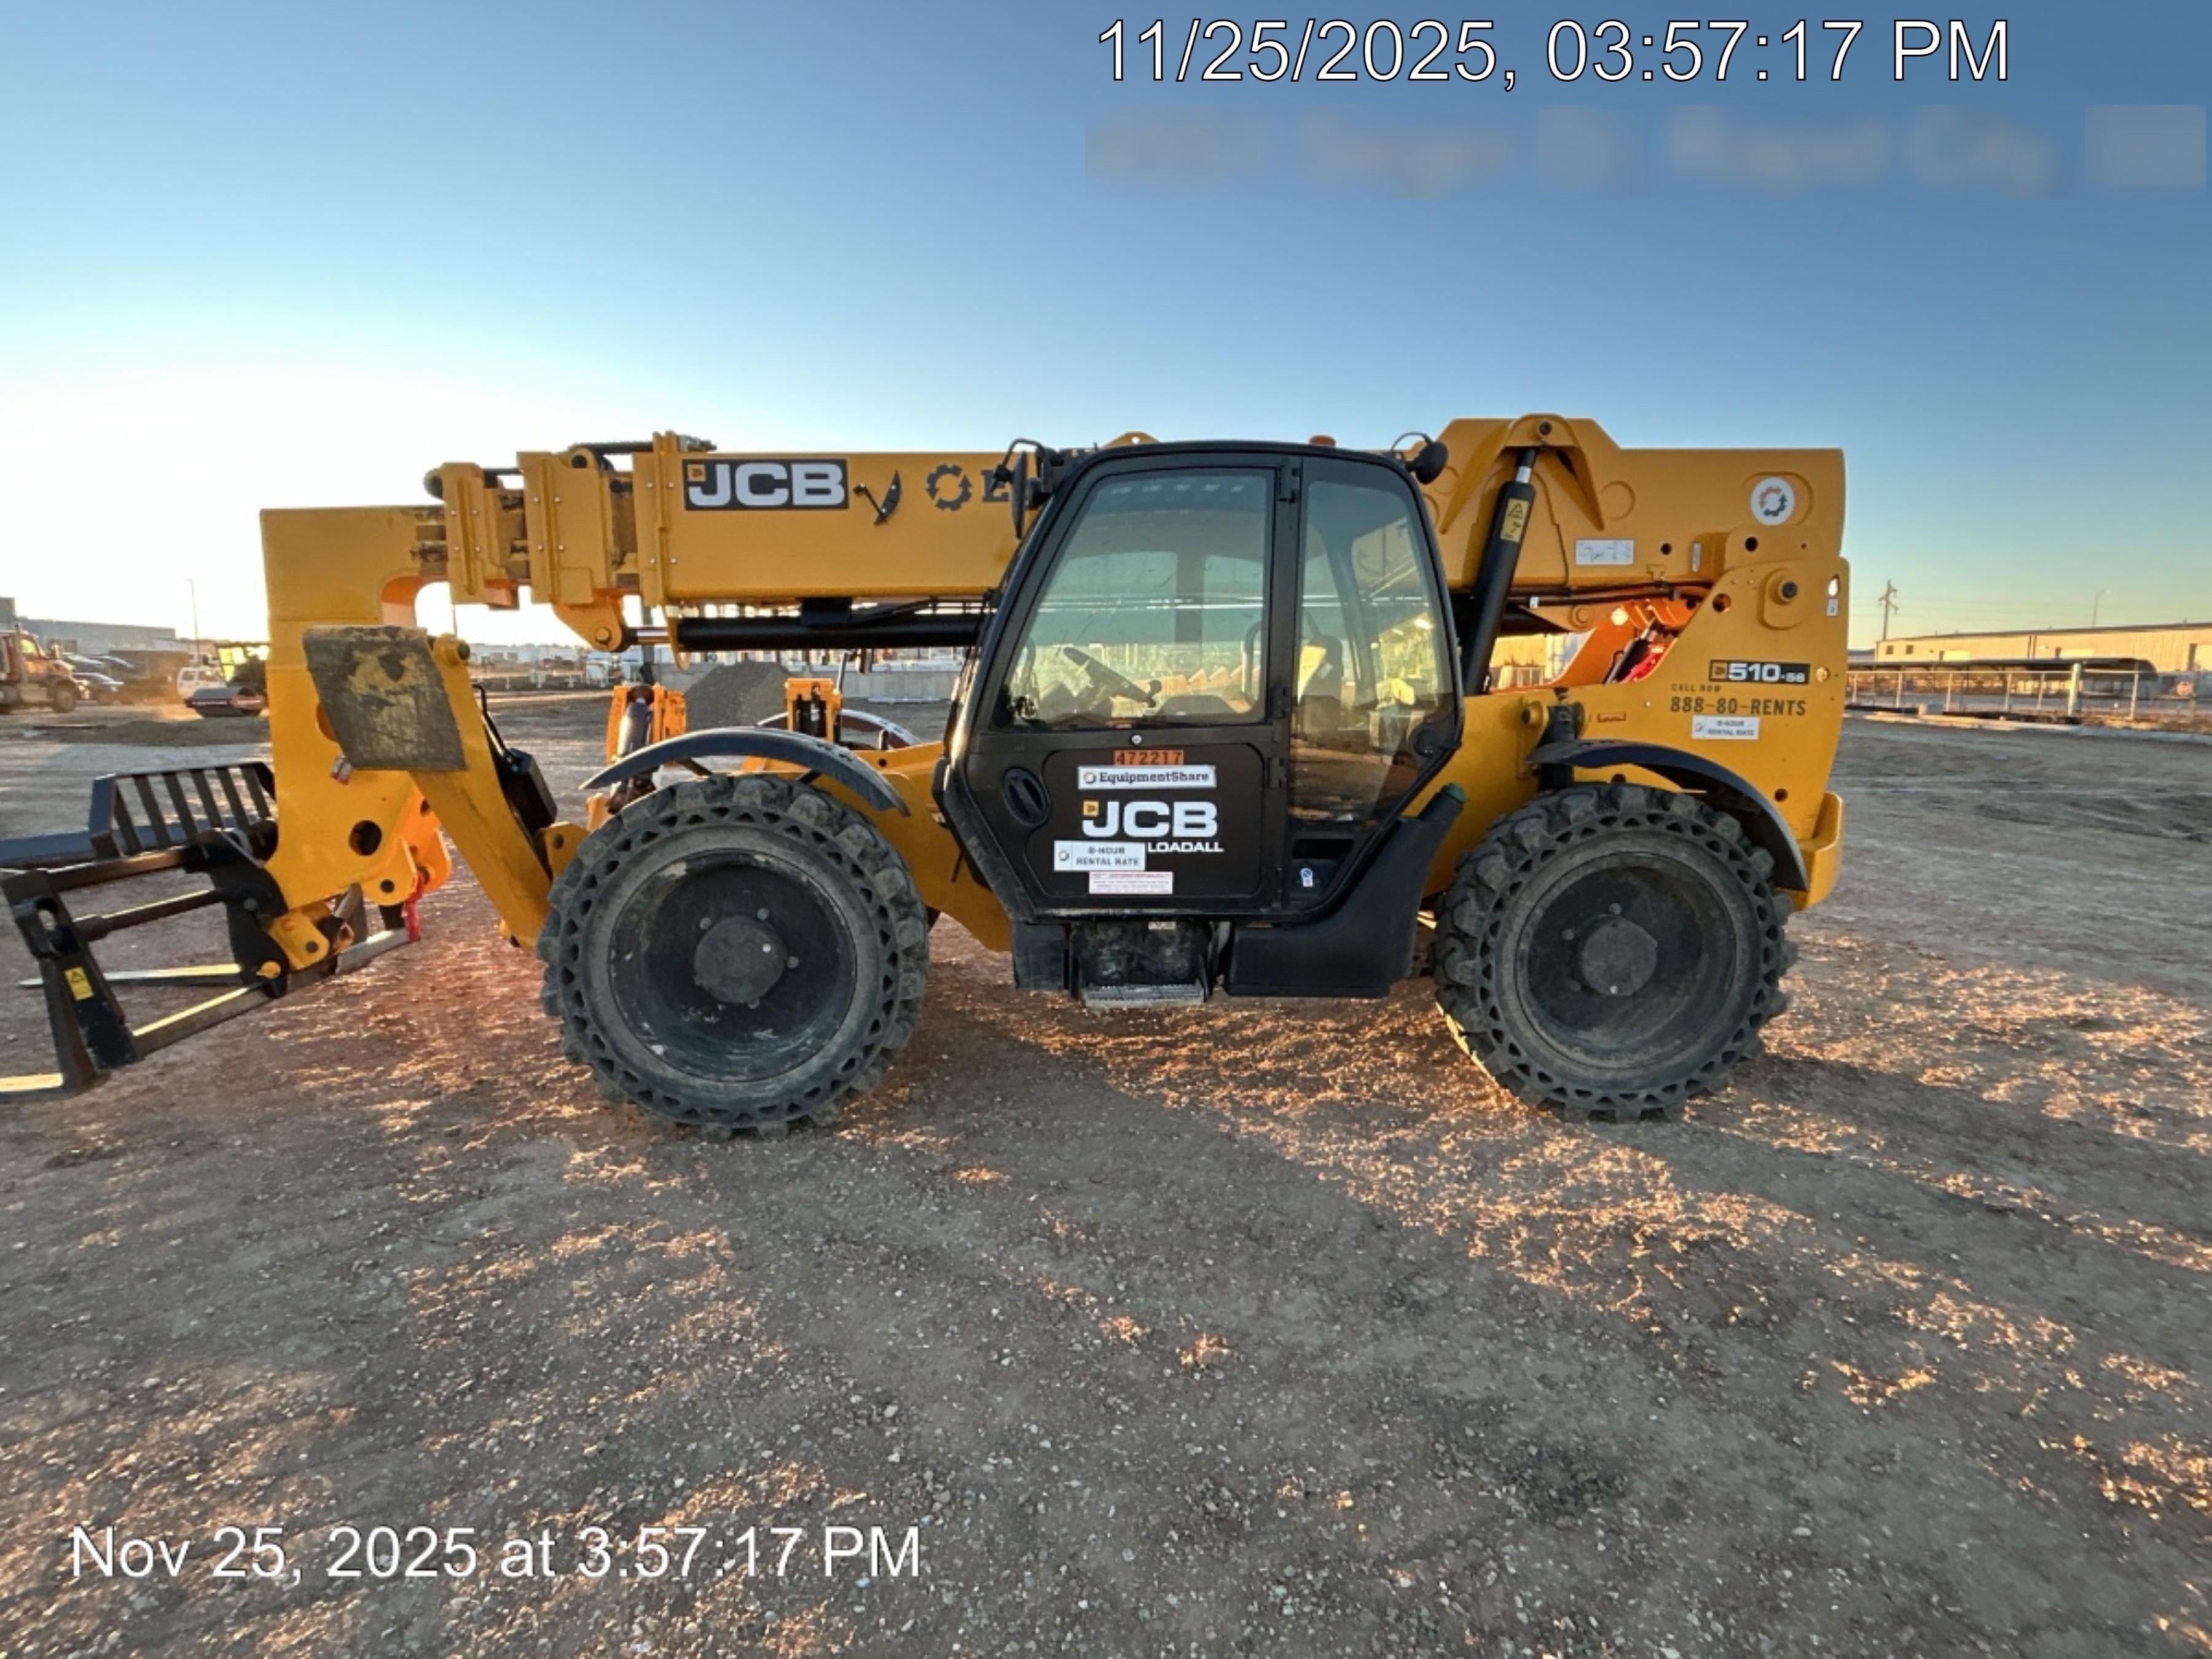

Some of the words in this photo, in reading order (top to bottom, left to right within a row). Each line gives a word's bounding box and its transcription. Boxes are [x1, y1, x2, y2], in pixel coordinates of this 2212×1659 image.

[688, 463, 845, 506] JCB
[1670, 696, 1806, 716] 888-80-RENTS
[1116, 751, 1182, 766] 472217
[1099, 771, 1209, 784] EquipmentShare
[1082, 801, 1218, 837] JCB
[1147, 842, 1224, 852] LOADALL
